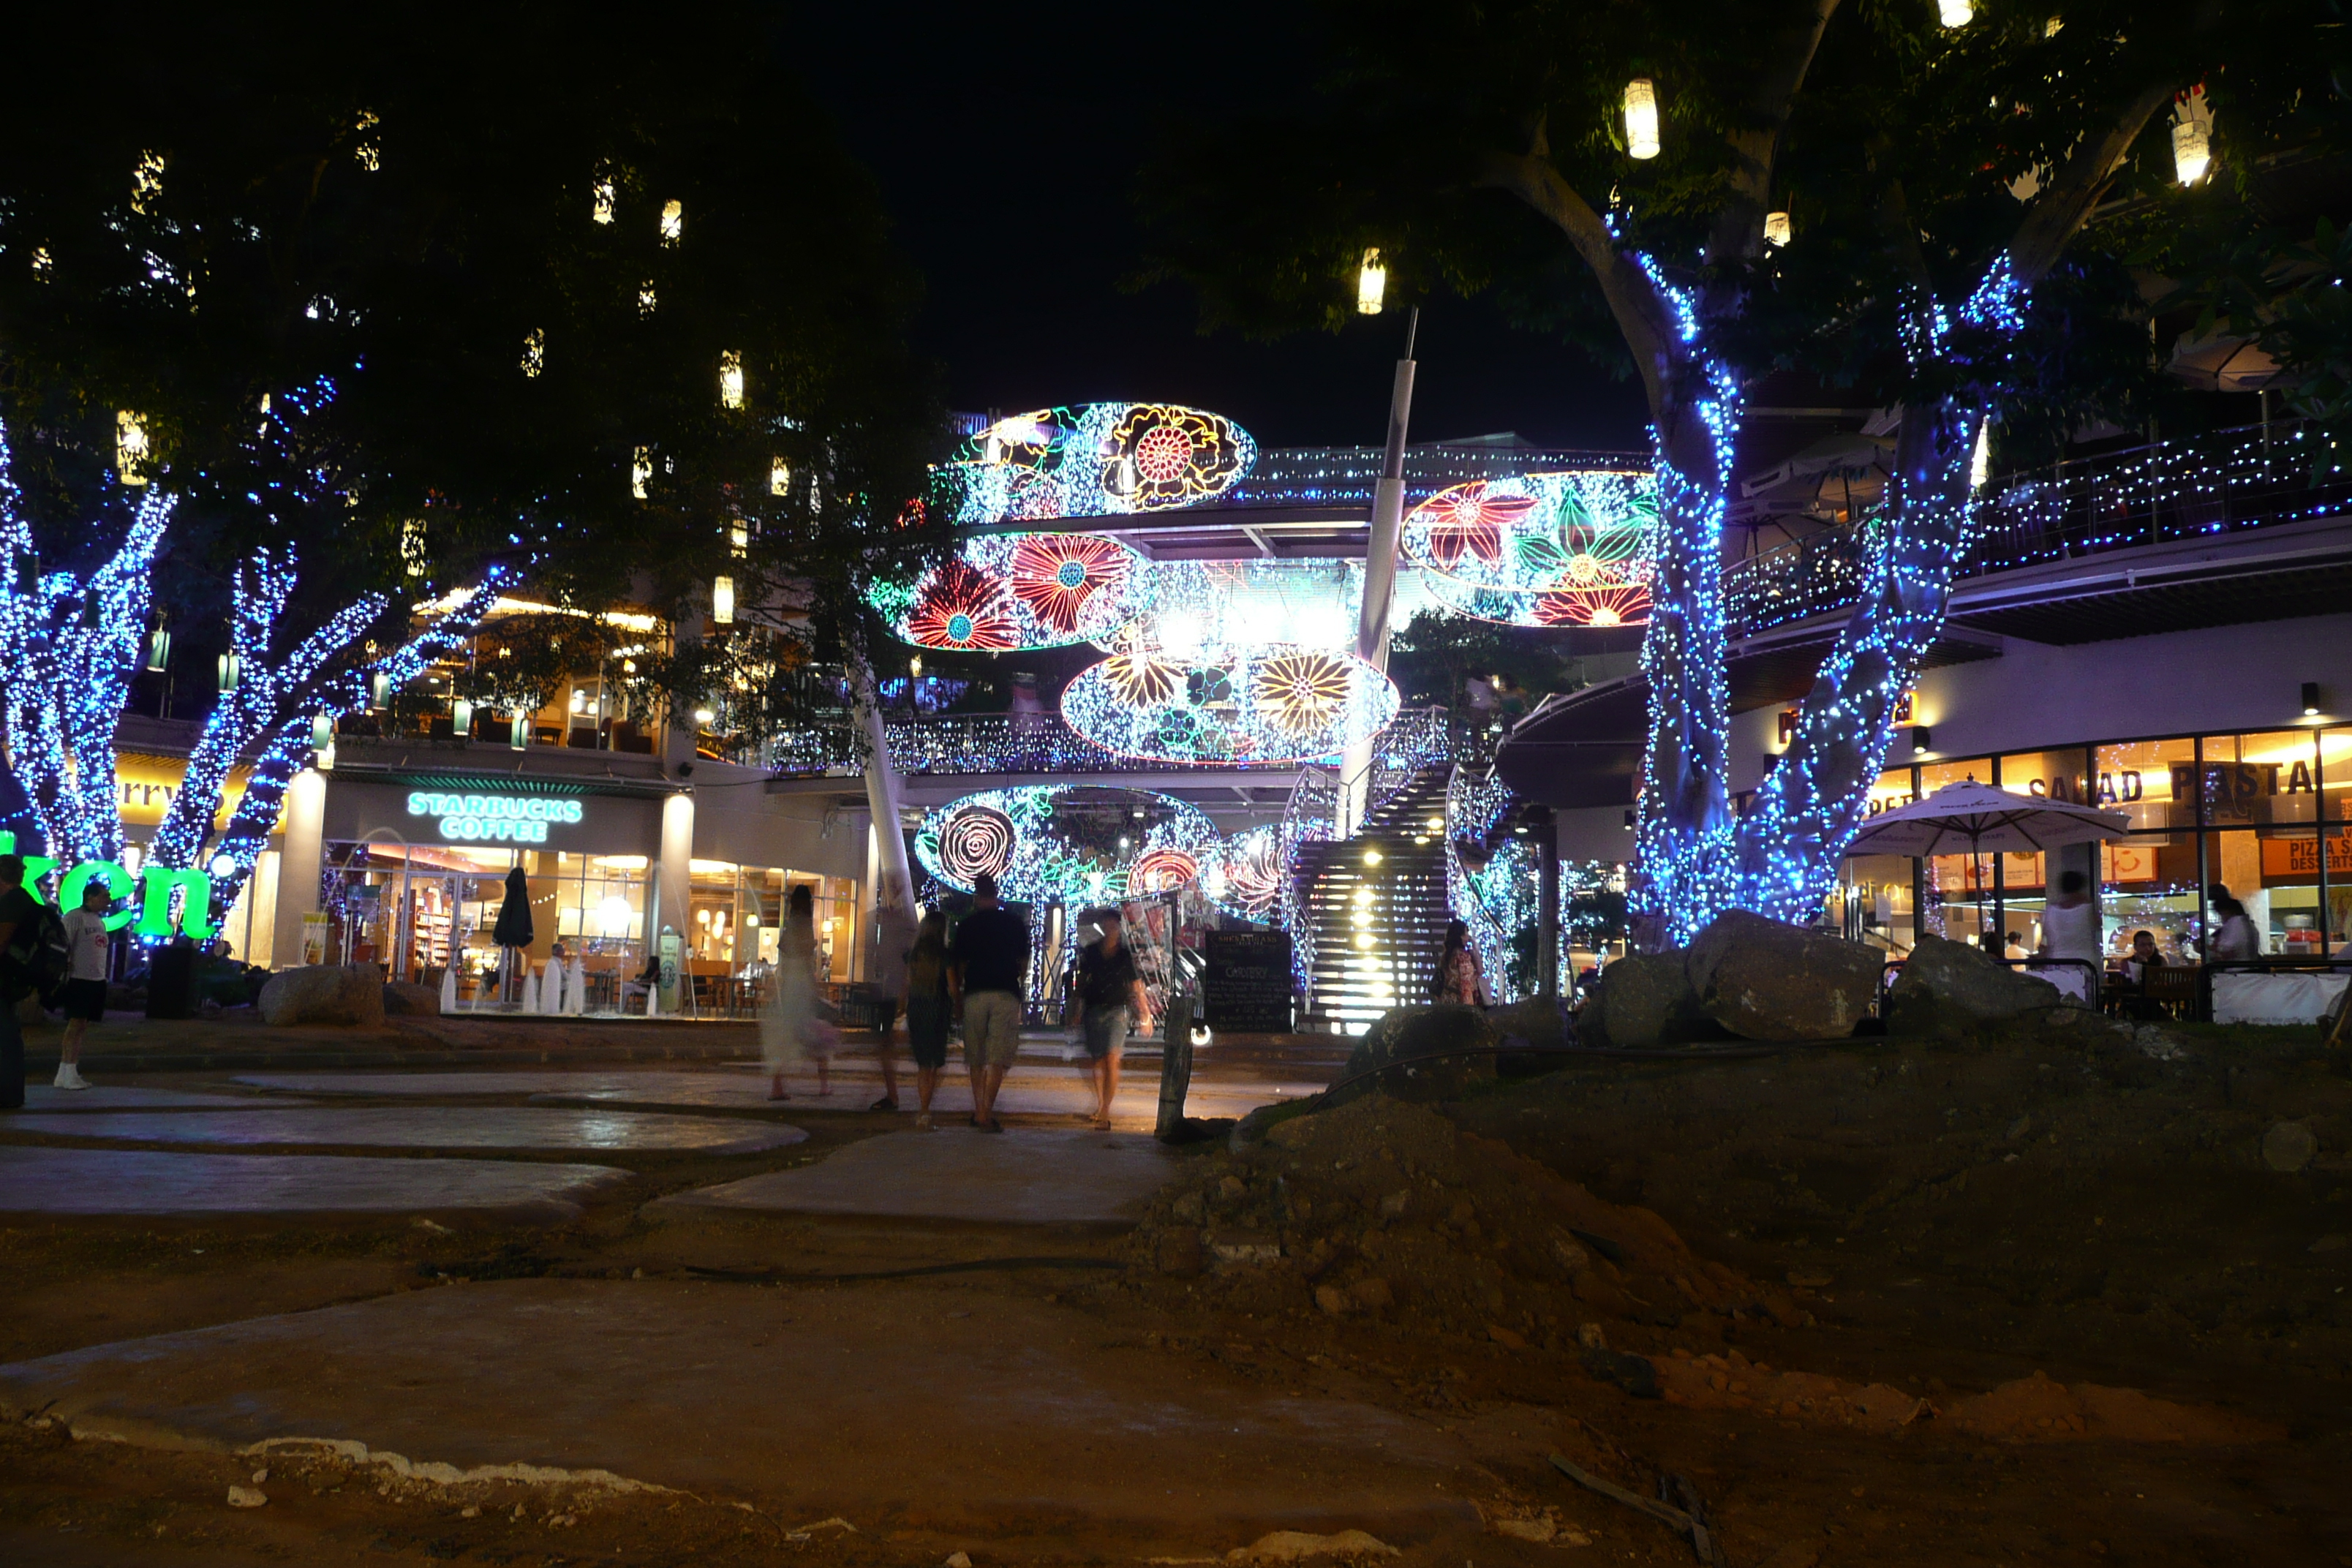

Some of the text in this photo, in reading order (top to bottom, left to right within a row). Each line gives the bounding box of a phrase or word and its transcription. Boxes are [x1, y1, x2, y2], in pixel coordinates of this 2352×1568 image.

[2173, 761, 2314, 800] PASTA
[408, 793, 583, 823] STARBUCKS
[440, 816, 548, 842] COFFEE
[2291, 841, 2334, 858] PIZA
